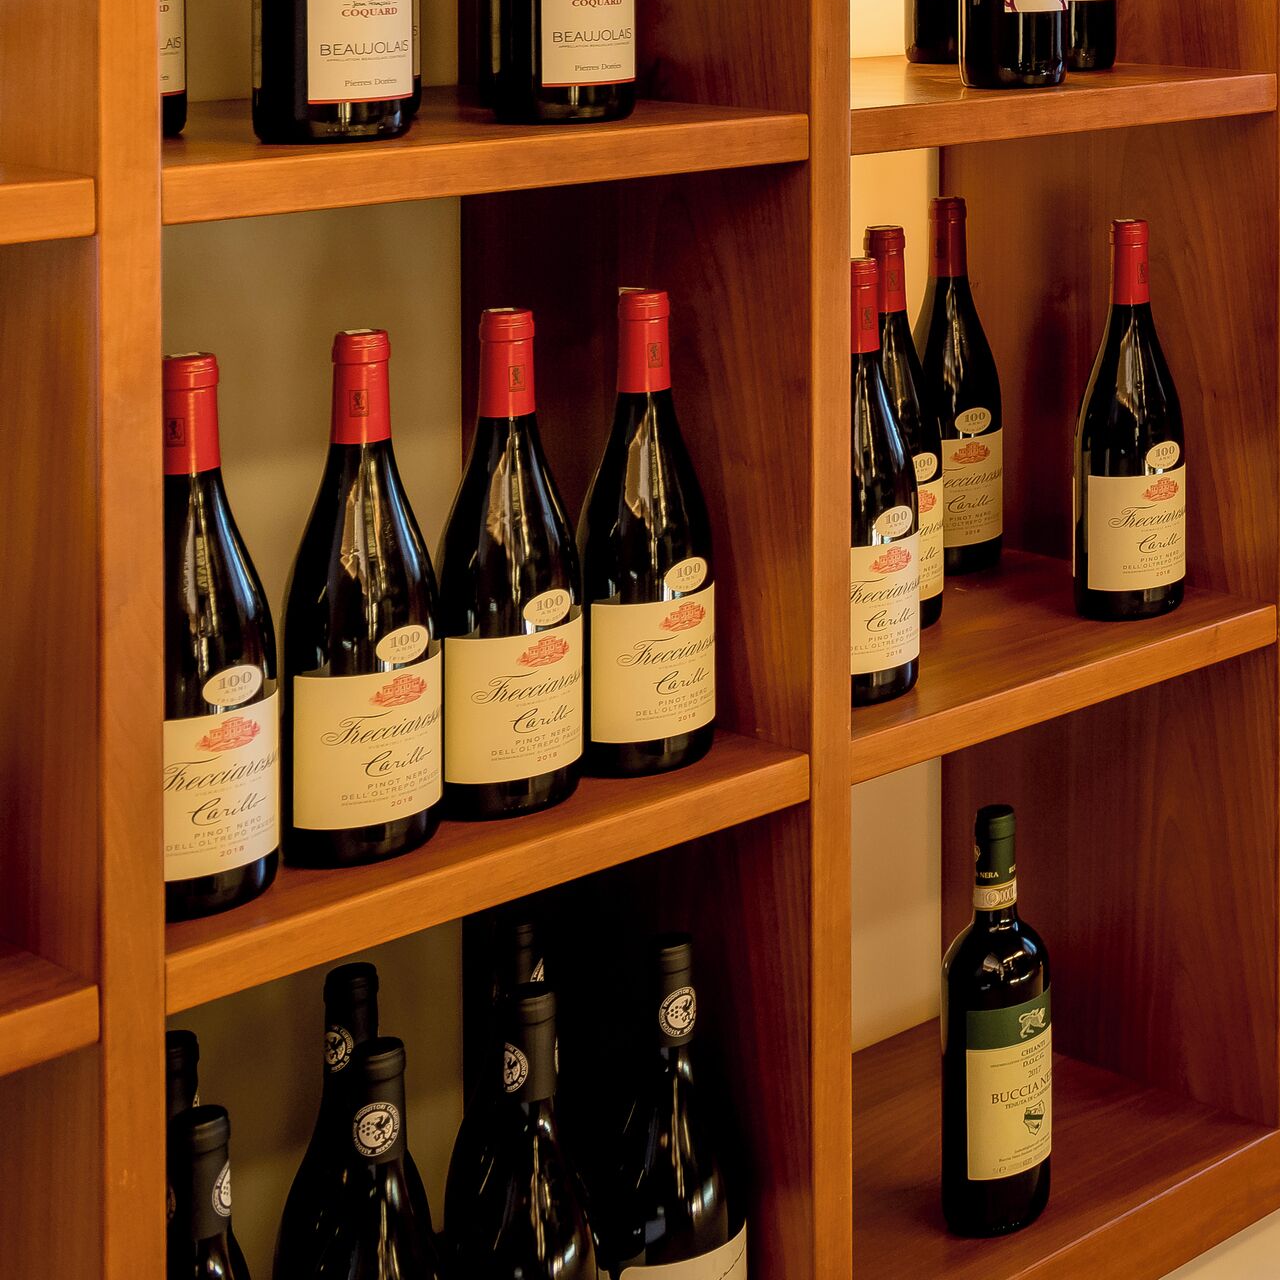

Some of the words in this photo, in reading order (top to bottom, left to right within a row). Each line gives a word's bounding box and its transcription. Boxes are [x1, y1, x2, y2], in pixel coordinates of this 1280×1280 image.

[341, 7, 398, 18] COQUARD
[552, 27, 632, 43] BEAUJOLAIS
[319, 39, 409, 56] BEAUJOLAIS
[574, 63, 599, 71] Pierres
[344, 78, 372, 87] Pierres
[964, 411, 986, 423] 100
[1155, 445, 1175, 458] 100
[946, 494, 995, 513] Carillo
[885, 510, 907, 525] 100
[975, 510, 992, 519] NERO
[1108, 504, 1186, 529] Frecciaross
[965, 528, 981, 536] 2018
[1136, 532, 1182, 554] Carillo
[1140, 554, 1163, 563] PINOT
[1165, 549, 1179, 559] NERO
[676, 562, 701, 579] 100
[1156, 569, 1170, 577] 2018
[850, 574, 920, 605] Frecciaross
[536, 594, 564, 612] 100
[864, 607, 916, 633] Carillo
[388, 631, 421, 649] 100
[868, 632, 893, 644] PINOT
[896, 626, 913, 637] NERO
[886, 648, 902, 658] 2018
[217, 670, 253, 691] 100
[470, 670, 582, 705] Frecciaross
[653, 667, 710, 696] Carillo
[658, 694, 686, 707] PINOT
[689, 686, 708, 699] NERO
[509, 704, 576, 734] Carillo
[678, 711, 696, 722] 2018
[320, 705, 441, 747] Frecciaross
[515, 733, 546, 746] PINOT
[550, 725, 572, 737] NERO
[361, 745, 432, 778] Carillo
[537, 751, 558, 762] 2018
[163, 750, 278, 793] Frecciaross
[367, 777, 401, 790] PINOT
[405, 767, 428, 781] NERO
[187, 791, 267, 827] Carillo
[390, 795, 414, 808] 2018
[194, 825, 229, 840] PINOT
[236, 815, 263, 830] NERO
[218, 845, 245, 858] 2018
[1021, 1038, 1046, 1058] CHIANTI
[1028, 1064, 1042, 1078] 2017
[991, 1079, 1039, 1105] BUCCIA
[1005, 1098, 1027, 1110] TENUTA
